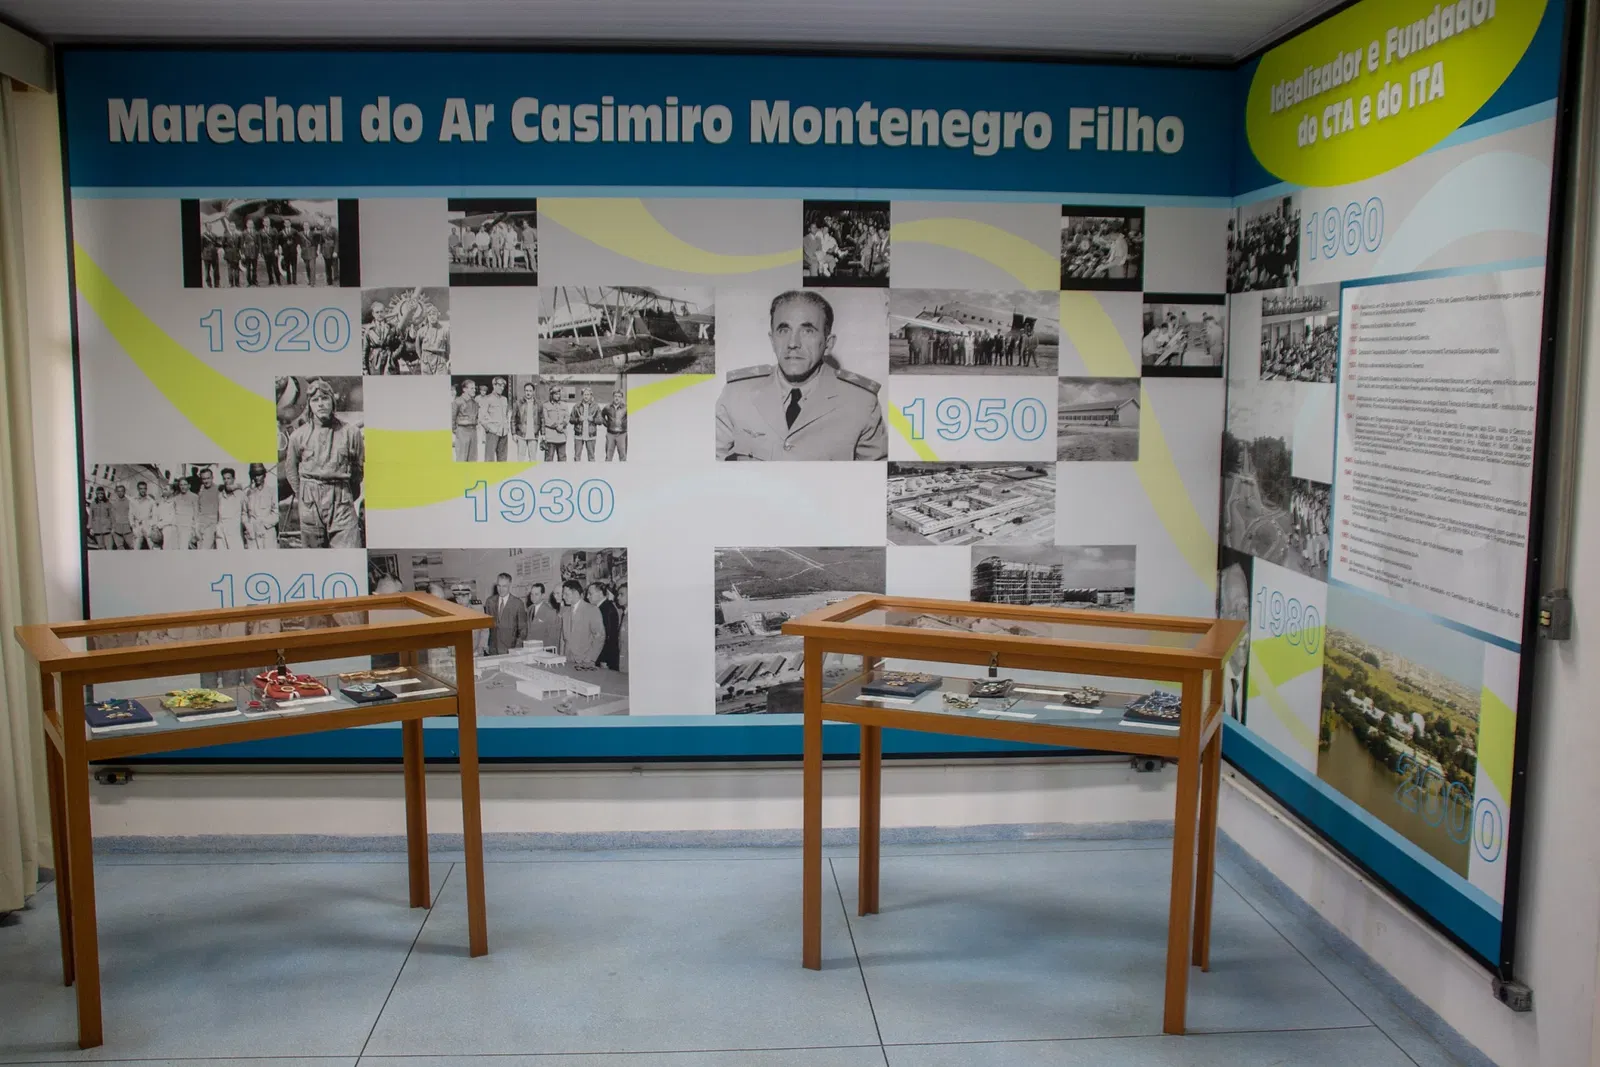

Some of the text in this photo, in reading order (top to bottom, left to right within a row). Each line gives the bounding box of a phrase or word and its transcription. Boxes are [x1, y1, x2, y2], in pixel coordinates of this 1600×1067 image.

[1270, 0, 1496, 114] Idealizador e Fundador
[108, 96, 1185, 156] Marechal do Ar Casimiro Montenegro Filho
[1297, 61, 1446, 147] do CTA e do ITA
[1306, 196, 1385, 261] 1960
[200, 307, 352, 352] 1920
[902, 397, 1048, 441] 1950
[464, 478, 615, 523] 1930
[210, 572, 359, 608] 1940
[1257, 586, 1321, 655] 1980
[1394, 752, 1503, 863] 2000
